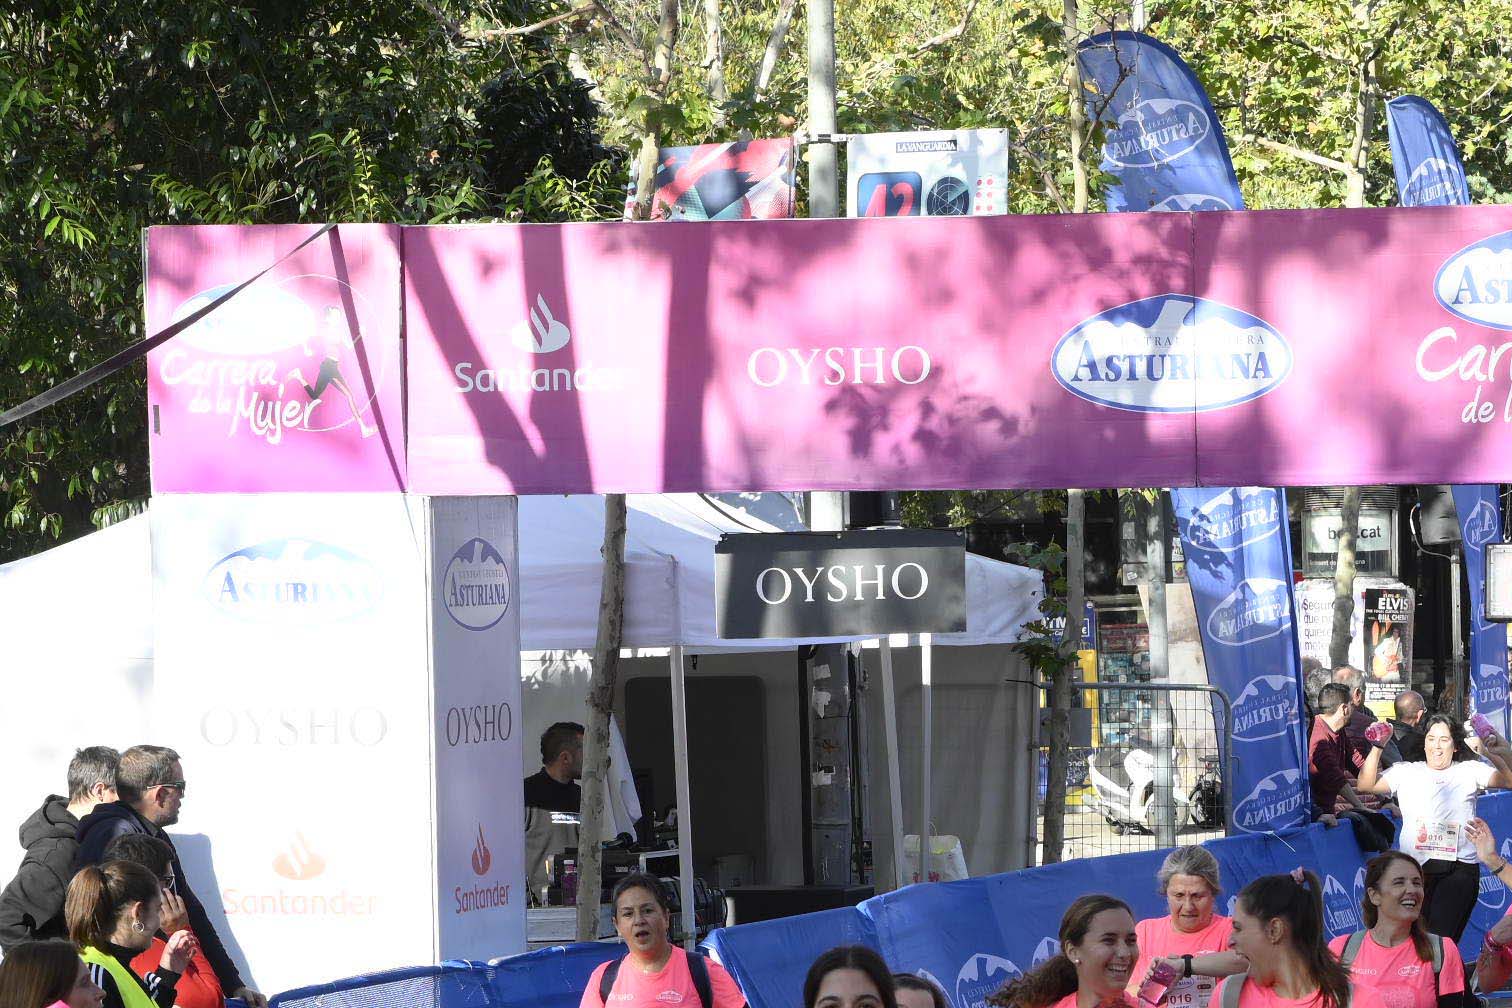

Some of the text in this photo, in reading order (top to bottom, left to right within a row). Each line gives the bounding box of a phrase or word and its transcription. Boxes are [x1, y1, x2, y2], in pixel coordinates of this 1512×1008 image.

[747, 345, 931, 388] OYSHO
[229, 383, 323, 445] Mujer
[1460, 386, 1495, 424] de
[218, 570, 372, 603] ASTURIANA
[448, 571, 507, 608] ASTURIANA
[756, 562, 929, 605] OYSHO
[1378, 597, 1409, 611] ELVIS
[200, 705, 388, 748] OYSHO
[447, 702, 512, 747] OYSHO
[455, 883, 511, 914] Santander
[1170, 994, 1192, 1005] 016
